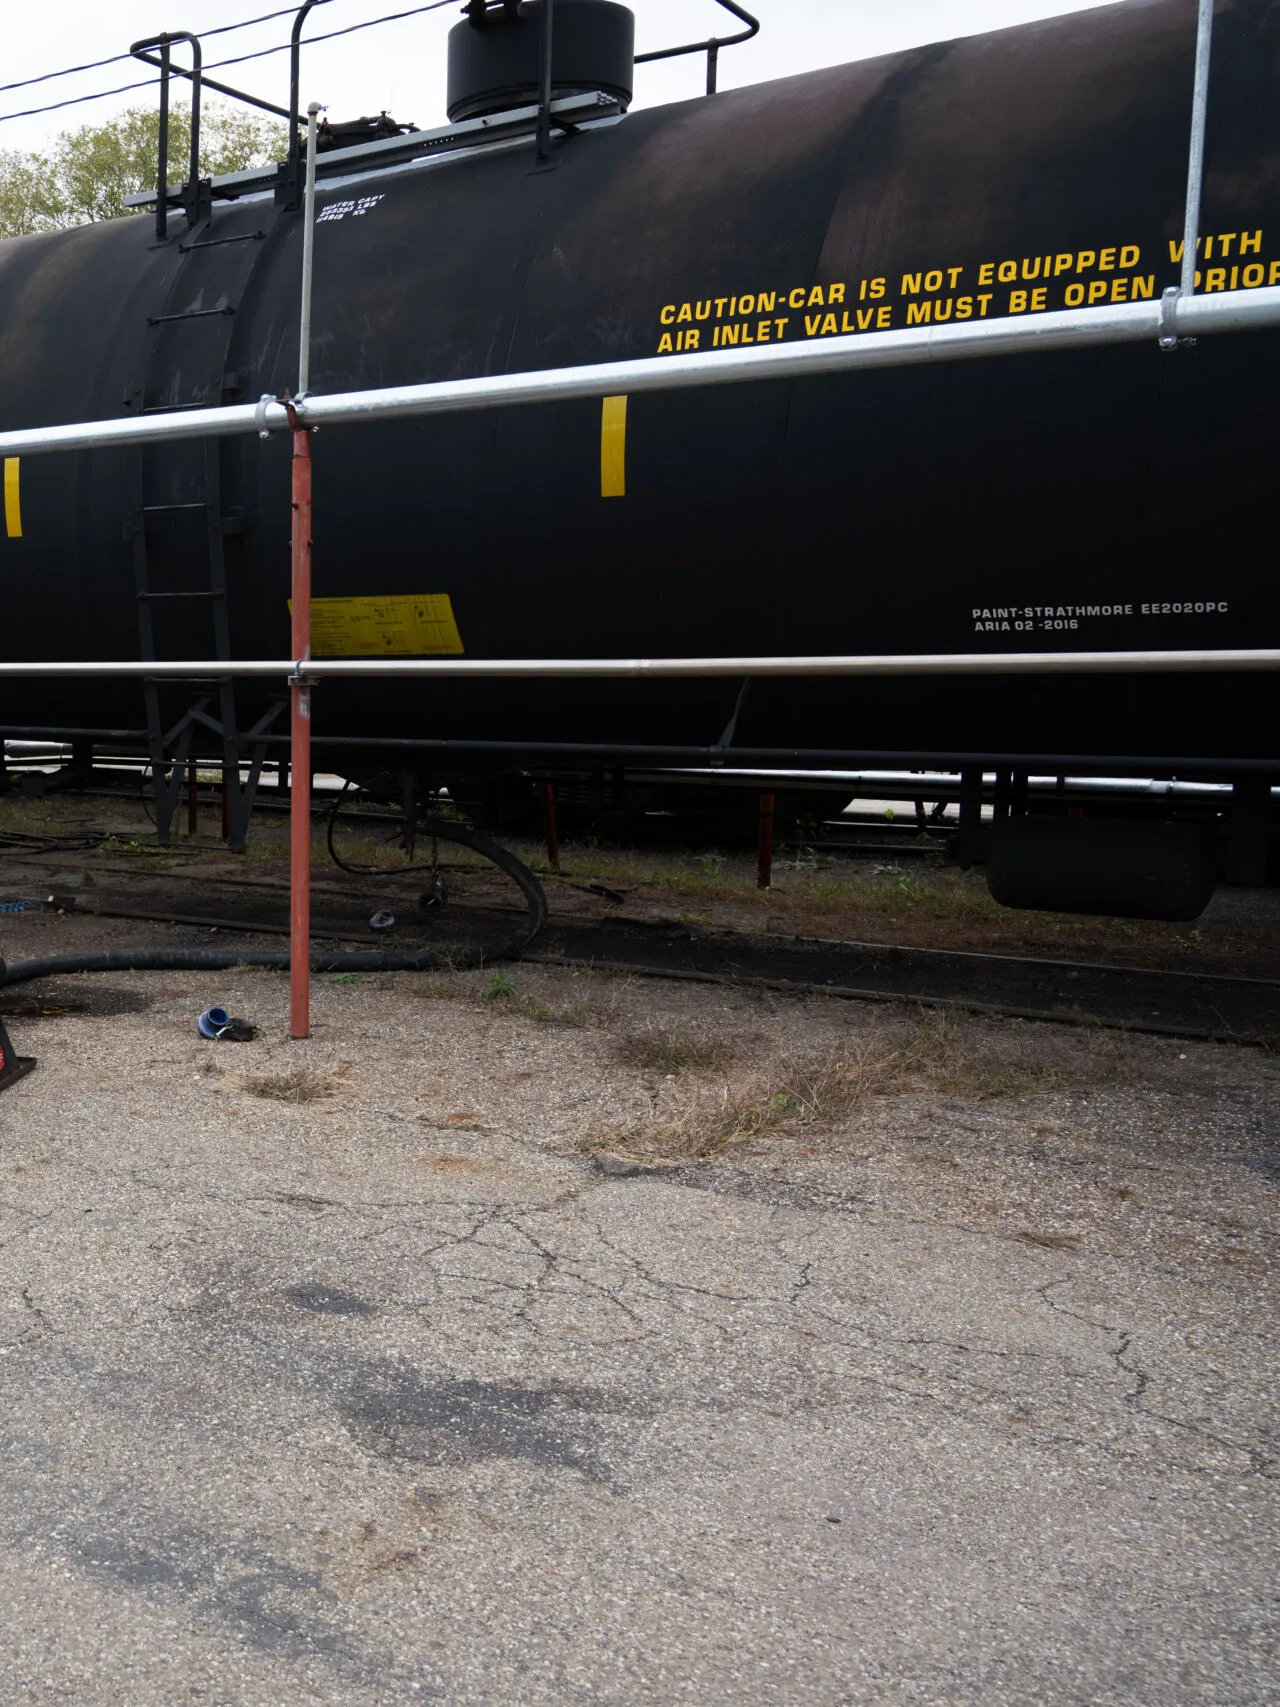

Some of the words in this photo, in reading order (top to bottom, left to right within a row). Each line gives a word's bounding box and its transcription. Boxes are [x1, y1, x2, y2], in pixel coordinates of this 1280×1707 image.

[659, 282, 846, 325] CAUTION-CAR
[859, 277, 886, 301] IS
[900, 267, 963, 296] NOT
[978, 245, 1141, 286] EQUIPPED
[657, 328, 700, 353] AIR
[712, 318, 789, 347] INLET
[804, 305, 892, 336] VALVE
[906, 293, 993, 325] MUST
[1009, 287, 1048, 313] BE
[1064, 274, 1155, 307] OPEN
[972, 604, 1133, 619] PAINT-STRATHMORE
[1141, 602, 1229, 614] EE2020PC
[974, 621, 1011, 632] ARIA
[1015, 620, 1034, 631] 02
